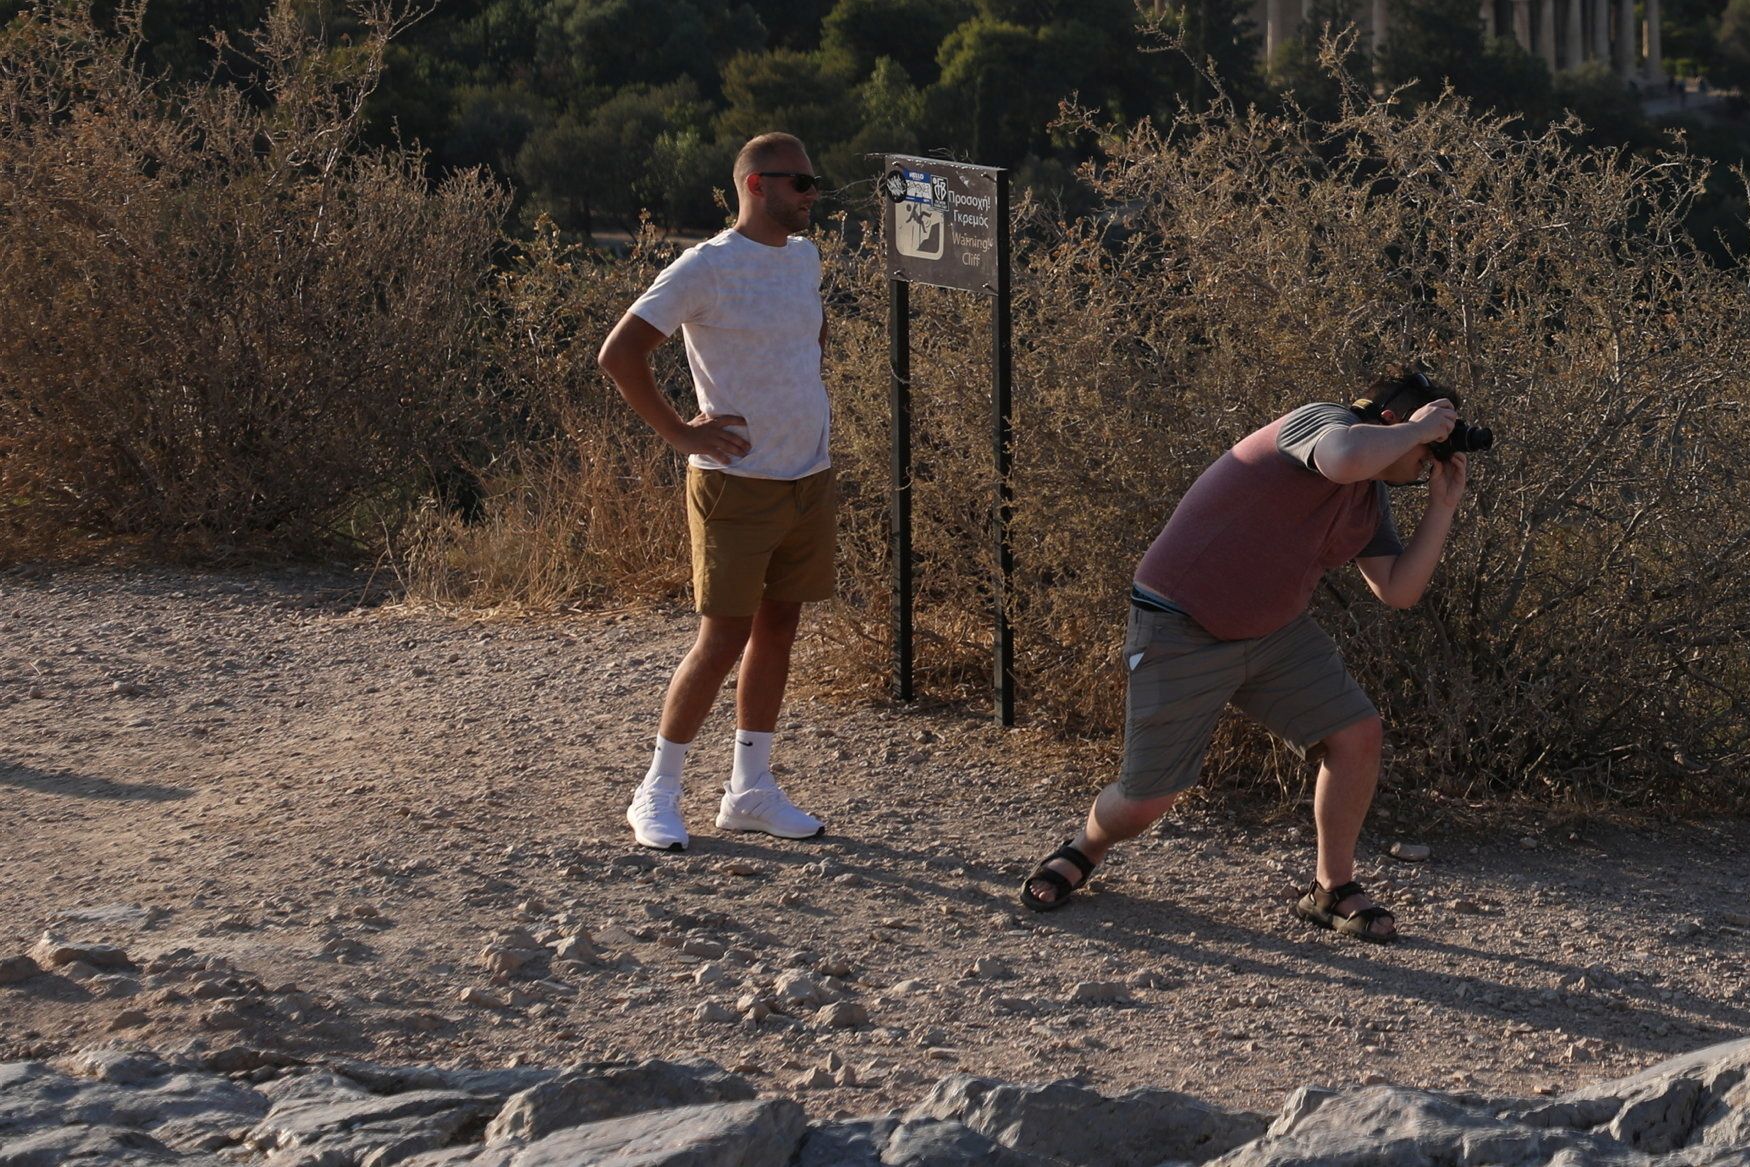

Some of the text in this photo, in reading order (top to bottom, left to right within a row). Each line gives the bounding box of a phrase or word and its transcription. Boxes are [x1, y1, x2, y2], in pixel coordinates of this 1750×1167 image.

[948, 190, 991, 211] Προσοχή!
[953, 209, 989, 230] Γκρεμός
[962, 252, 981, 268] Cliff
